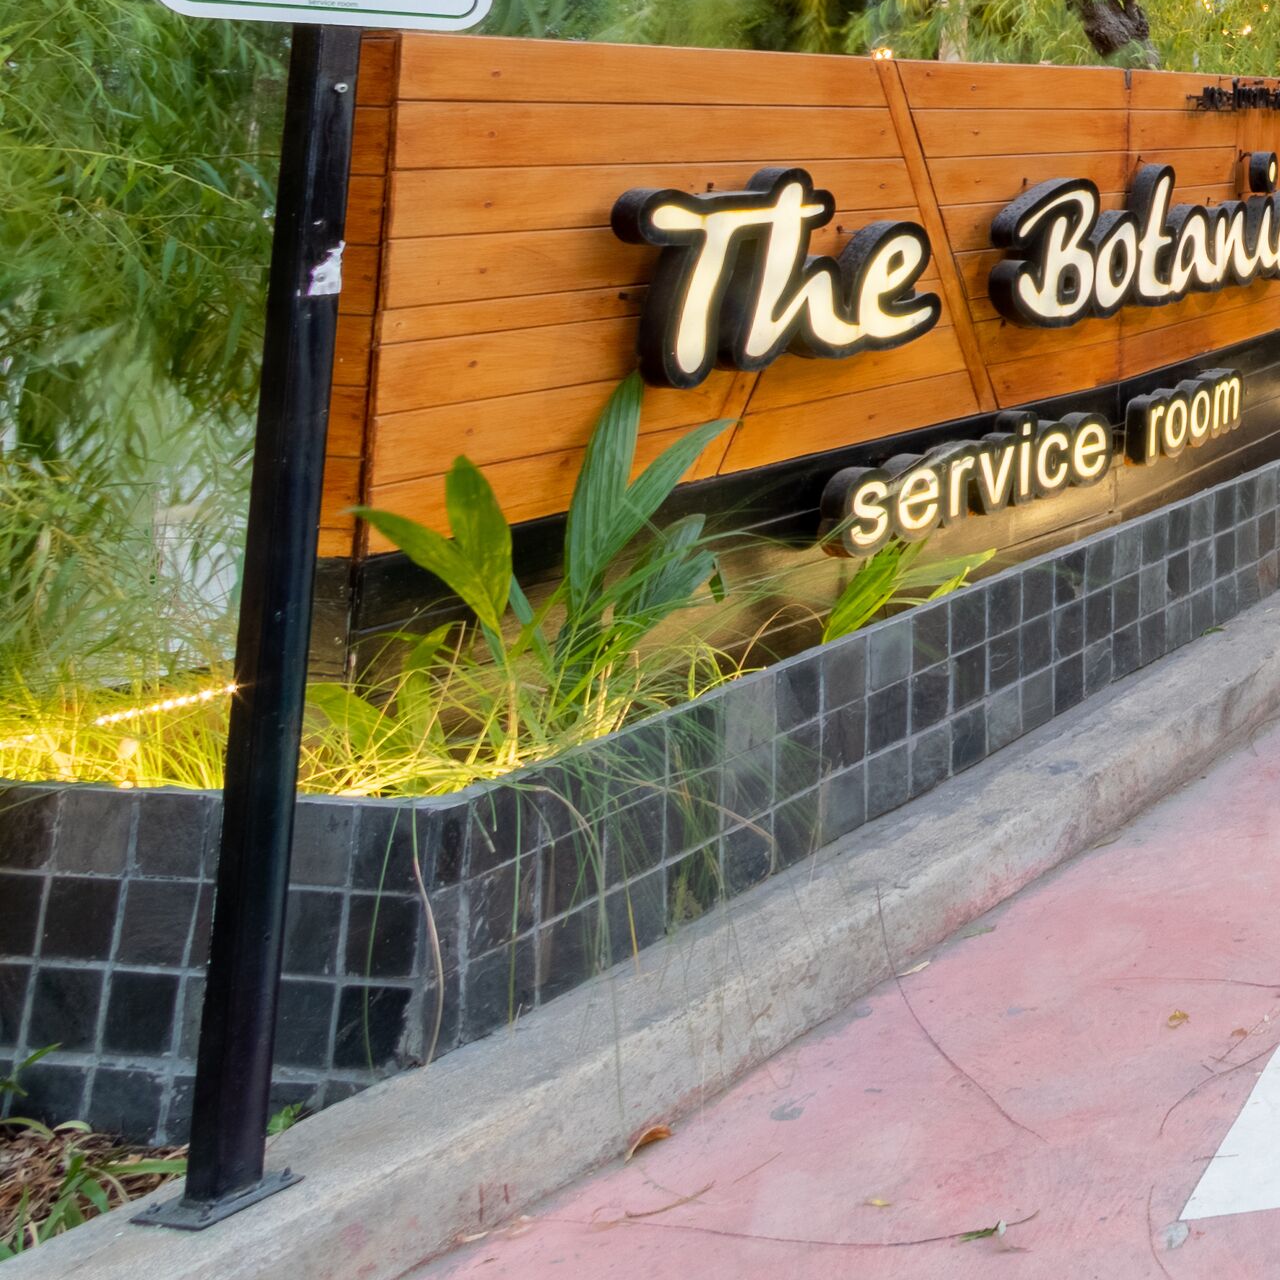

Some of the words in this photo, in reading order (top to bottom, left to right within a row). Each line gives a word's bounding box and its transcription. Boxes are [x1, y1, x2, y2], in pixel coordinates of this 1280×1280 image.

[650, 181, 937, 376] The
[850, 420, 1108, 547] service
[1147, 375, 1242, 460] room
